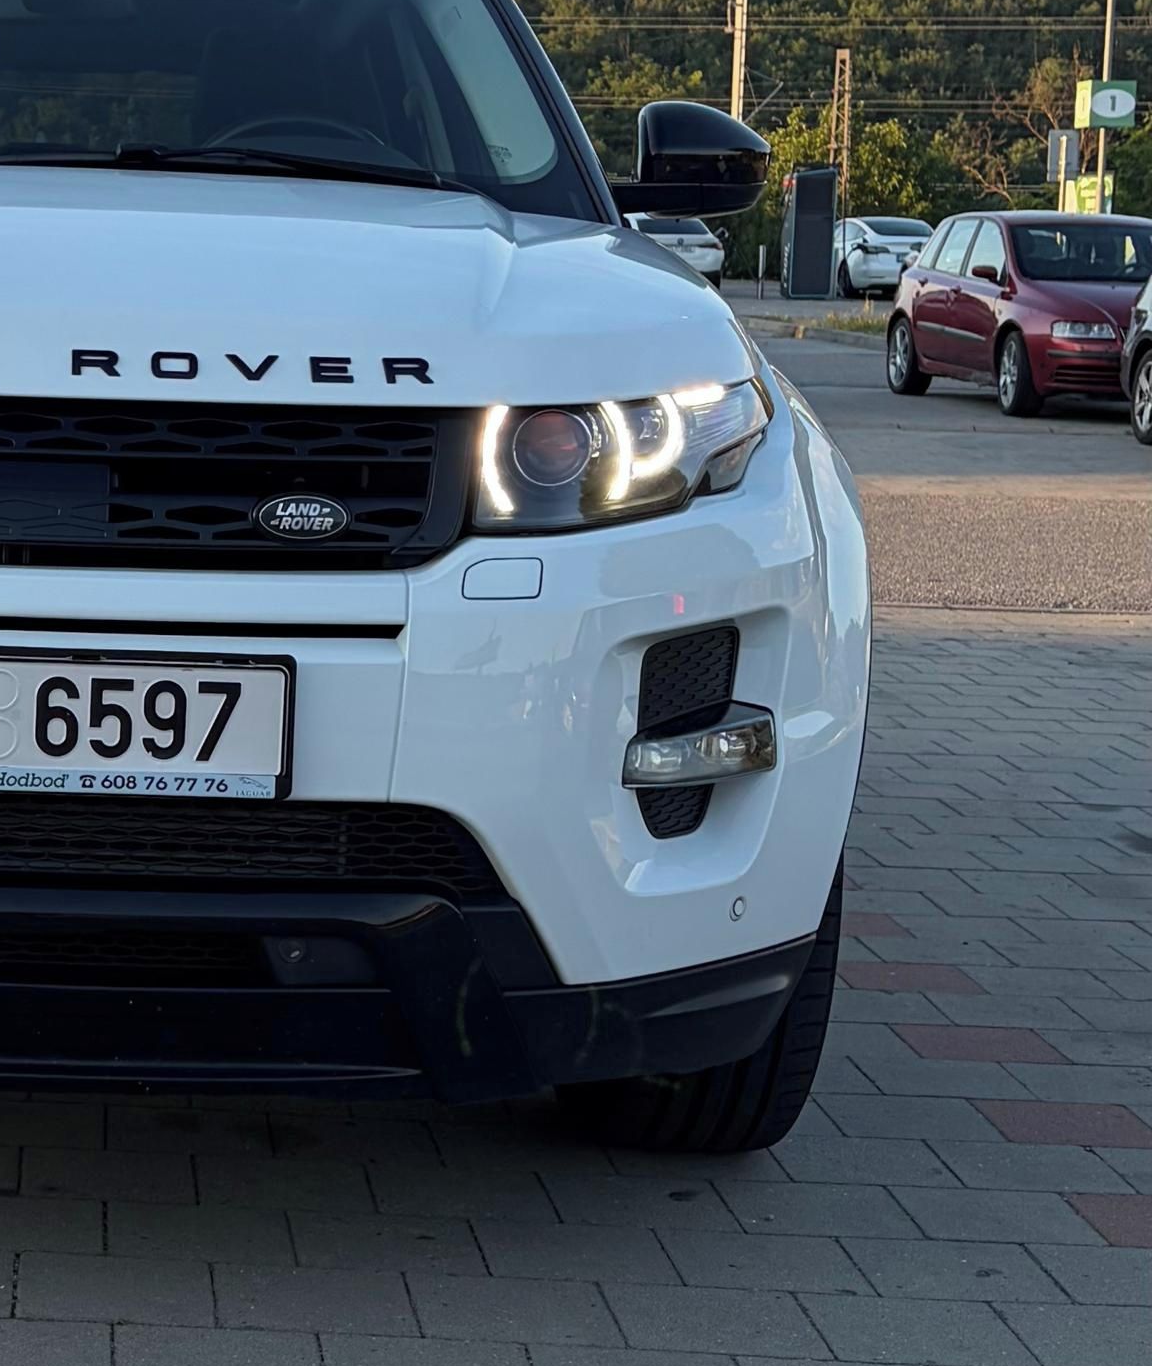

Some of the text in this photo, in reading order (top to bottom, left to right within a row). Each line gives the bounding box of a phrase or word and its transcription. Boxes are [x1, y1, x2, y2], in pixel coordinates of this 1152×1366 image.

[1110, 95, 1117, 112] 1
[69, 348, 435, 385] ROVER
[275, 502, 321, 516] LAND
[279, 516, 335, 531] ROVER
[33, 676, 243, 763] 6597
[100, 774, 138, 791] 608
[143, 776, 168, 792] 76
[174, 777, 197, 793] 77
[204, 777, 229, 794] 76
